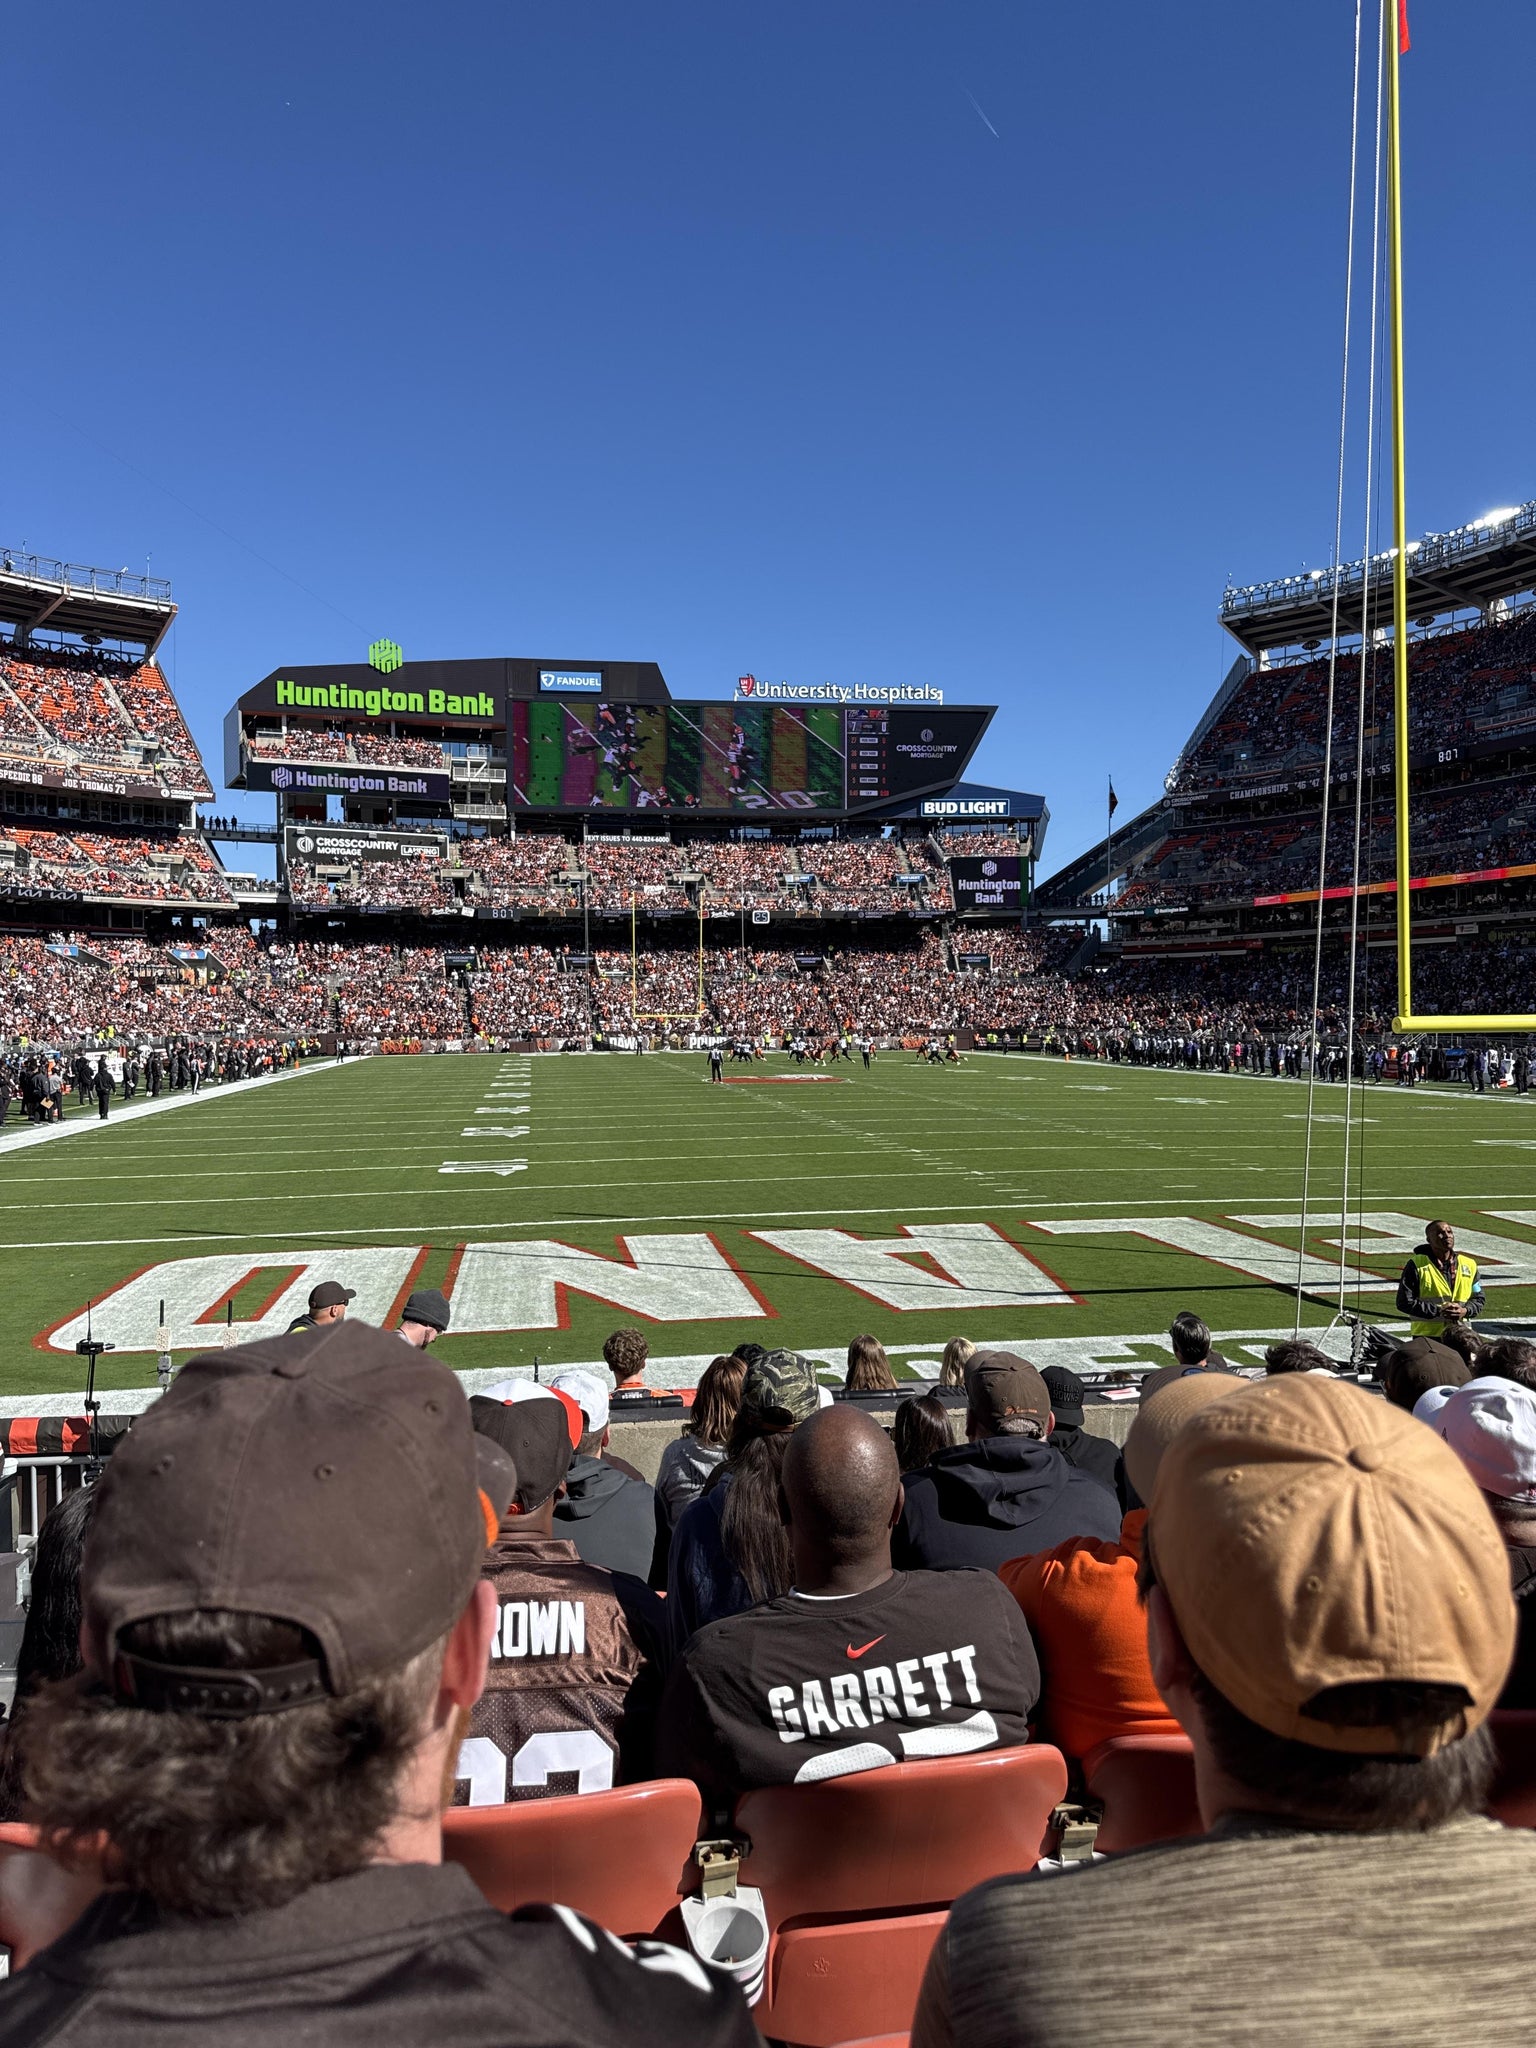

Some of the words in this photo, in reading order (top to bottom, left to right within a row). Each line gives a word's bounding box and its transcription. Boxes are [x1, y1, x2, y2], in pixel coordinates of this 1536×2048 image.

[556, 676, 601, 687] FANDUEL
[276, 680, 424, 716] Huntington
[428, 689, 494, 716] Bank
[755, 681, 850, 703] University
[854, 683, 939, 703] Hospitals
[896, 745, 958, 753] CROSSCOUNTRY
[0, 769, 30, 783] SPEEDIE
[31, 773, 43, 785] 88
[296, 771, 384, 793] Huntington
[388, 777, 427, 793] Bank
[62, 778, 78, 789] JOE
[80, 779, 114, 793] THOMAS
[114, 783, 126, 795] 73
[1229, 783, 1289, 800] CHAMPIONSHIPS
[924, 802, 958, 814] BUD
[959, 802, 1006, 814] LIGHT
[316, 837, 398, 851] CROSSCOUNTRY
[317, 846, 362, 856] MORTGAGE
[958, 879, 1021, 892] Huntington
[975, 892, 1004, 904] Bank
[767, 1645, 984, 1744] GARRETT
